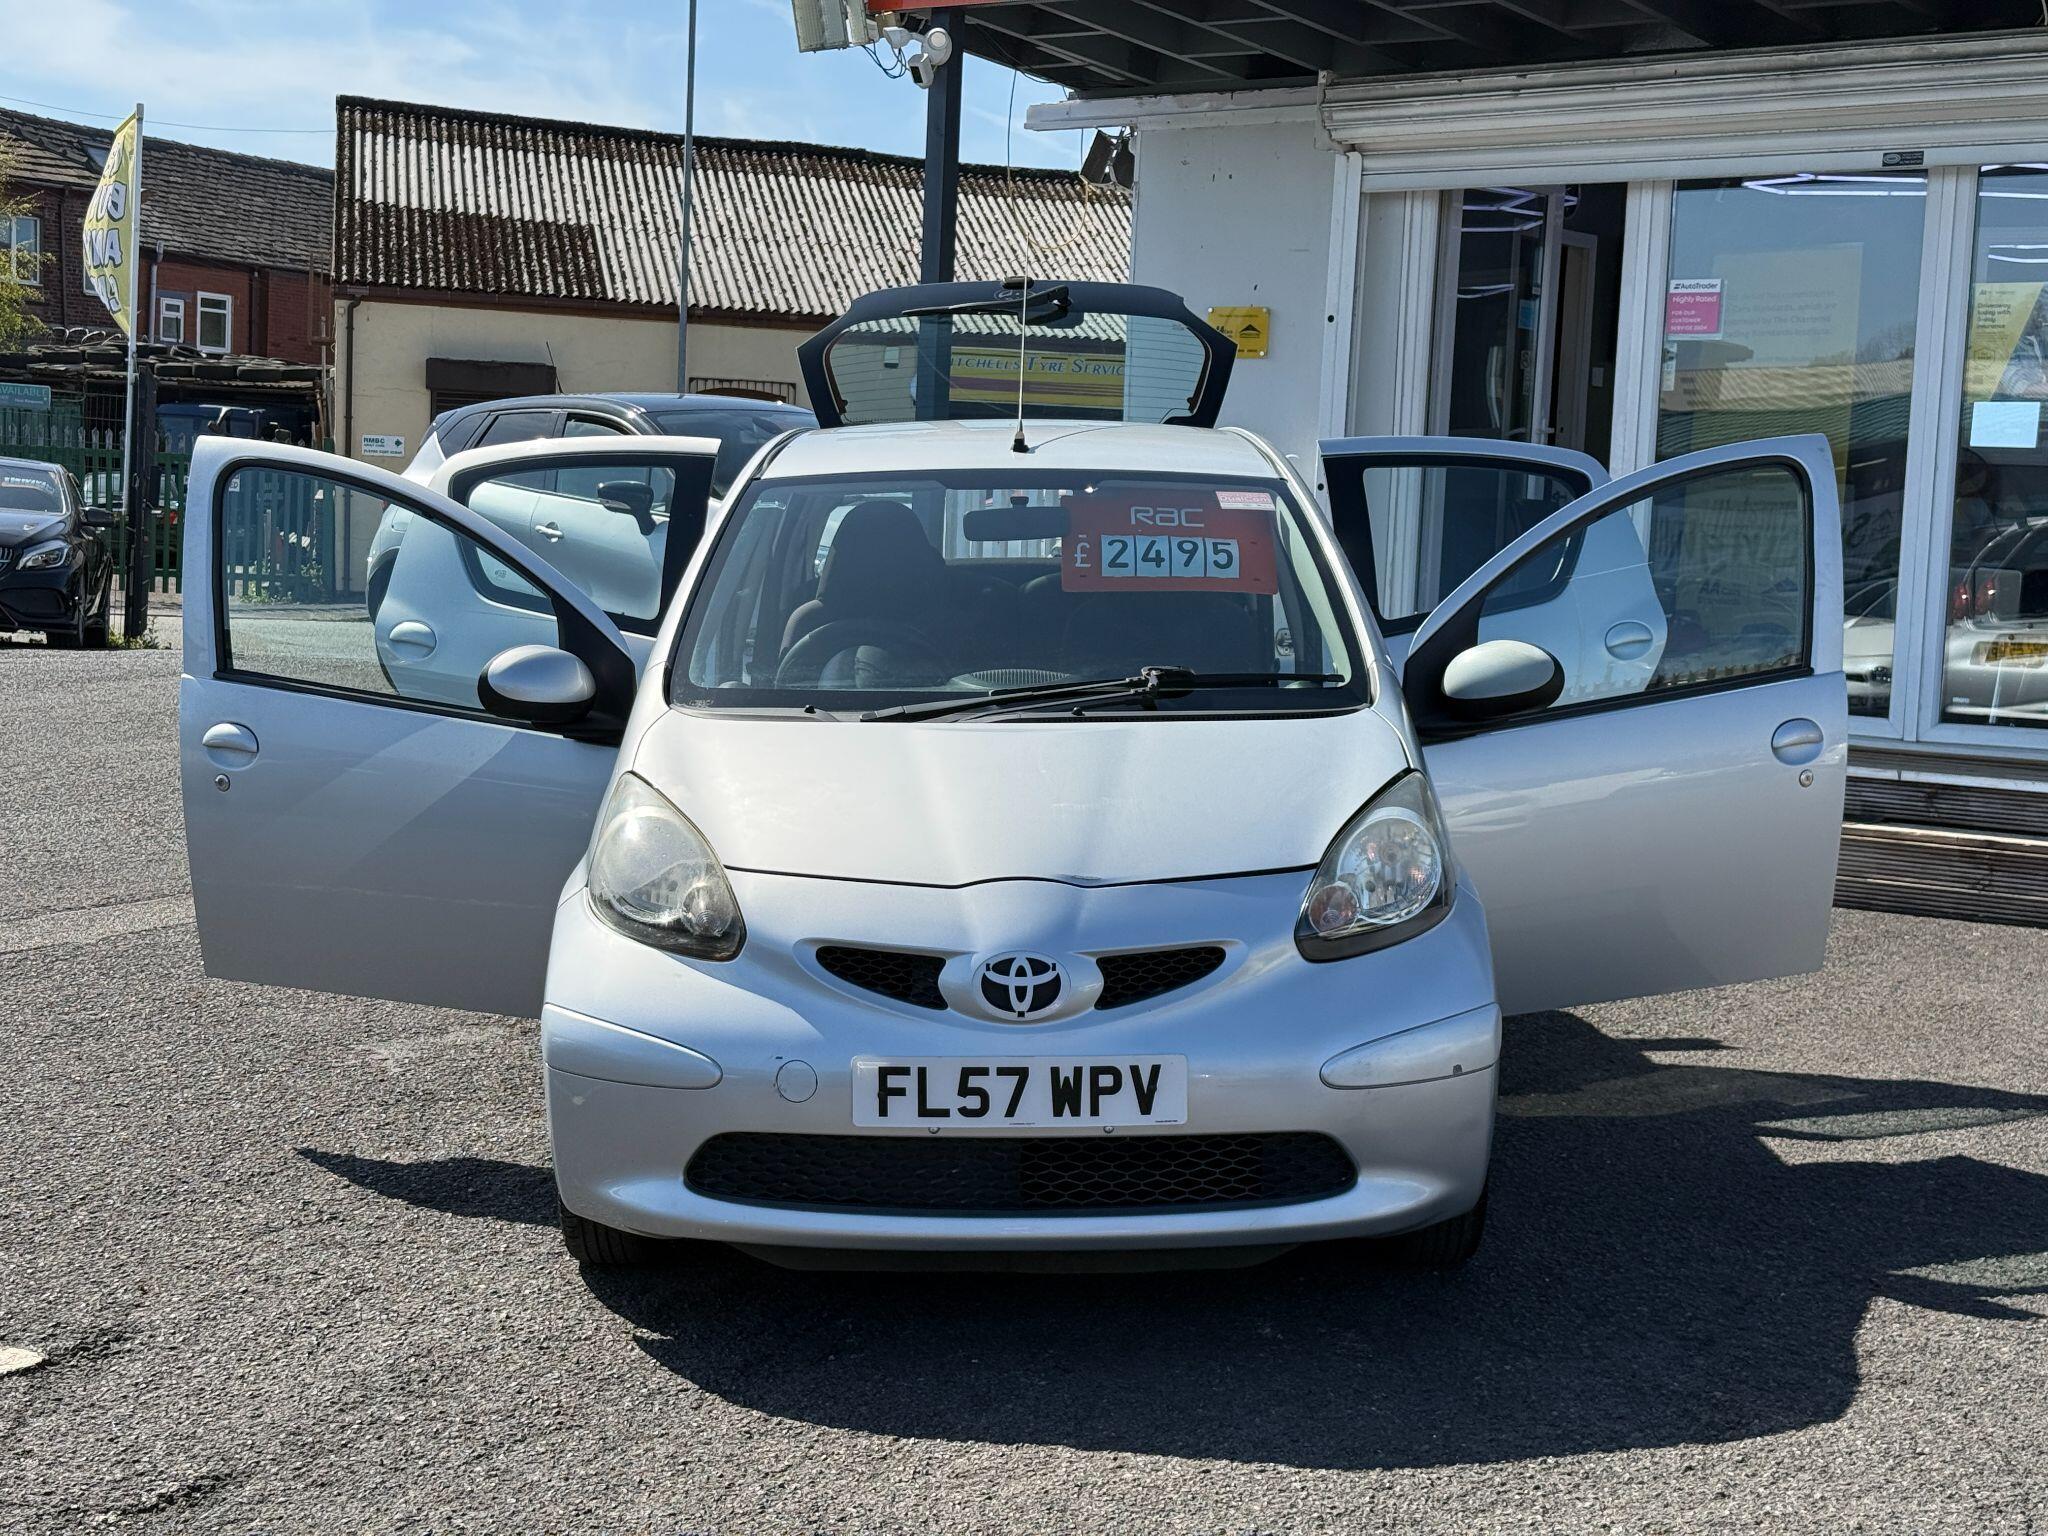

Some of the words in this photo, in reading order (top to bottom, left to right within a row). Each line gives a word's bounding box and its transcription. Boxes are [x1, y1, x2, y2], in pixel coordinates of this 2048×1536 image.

[1672, 296, 1695, 304] Highly
[1695, 295, 1718, 303] Rated
[950, 356, 1020, 370] ITCHELLS
[877, 1066, 1030, 1118] FL57
[1050, 1064, 1162, 1117] WPV
